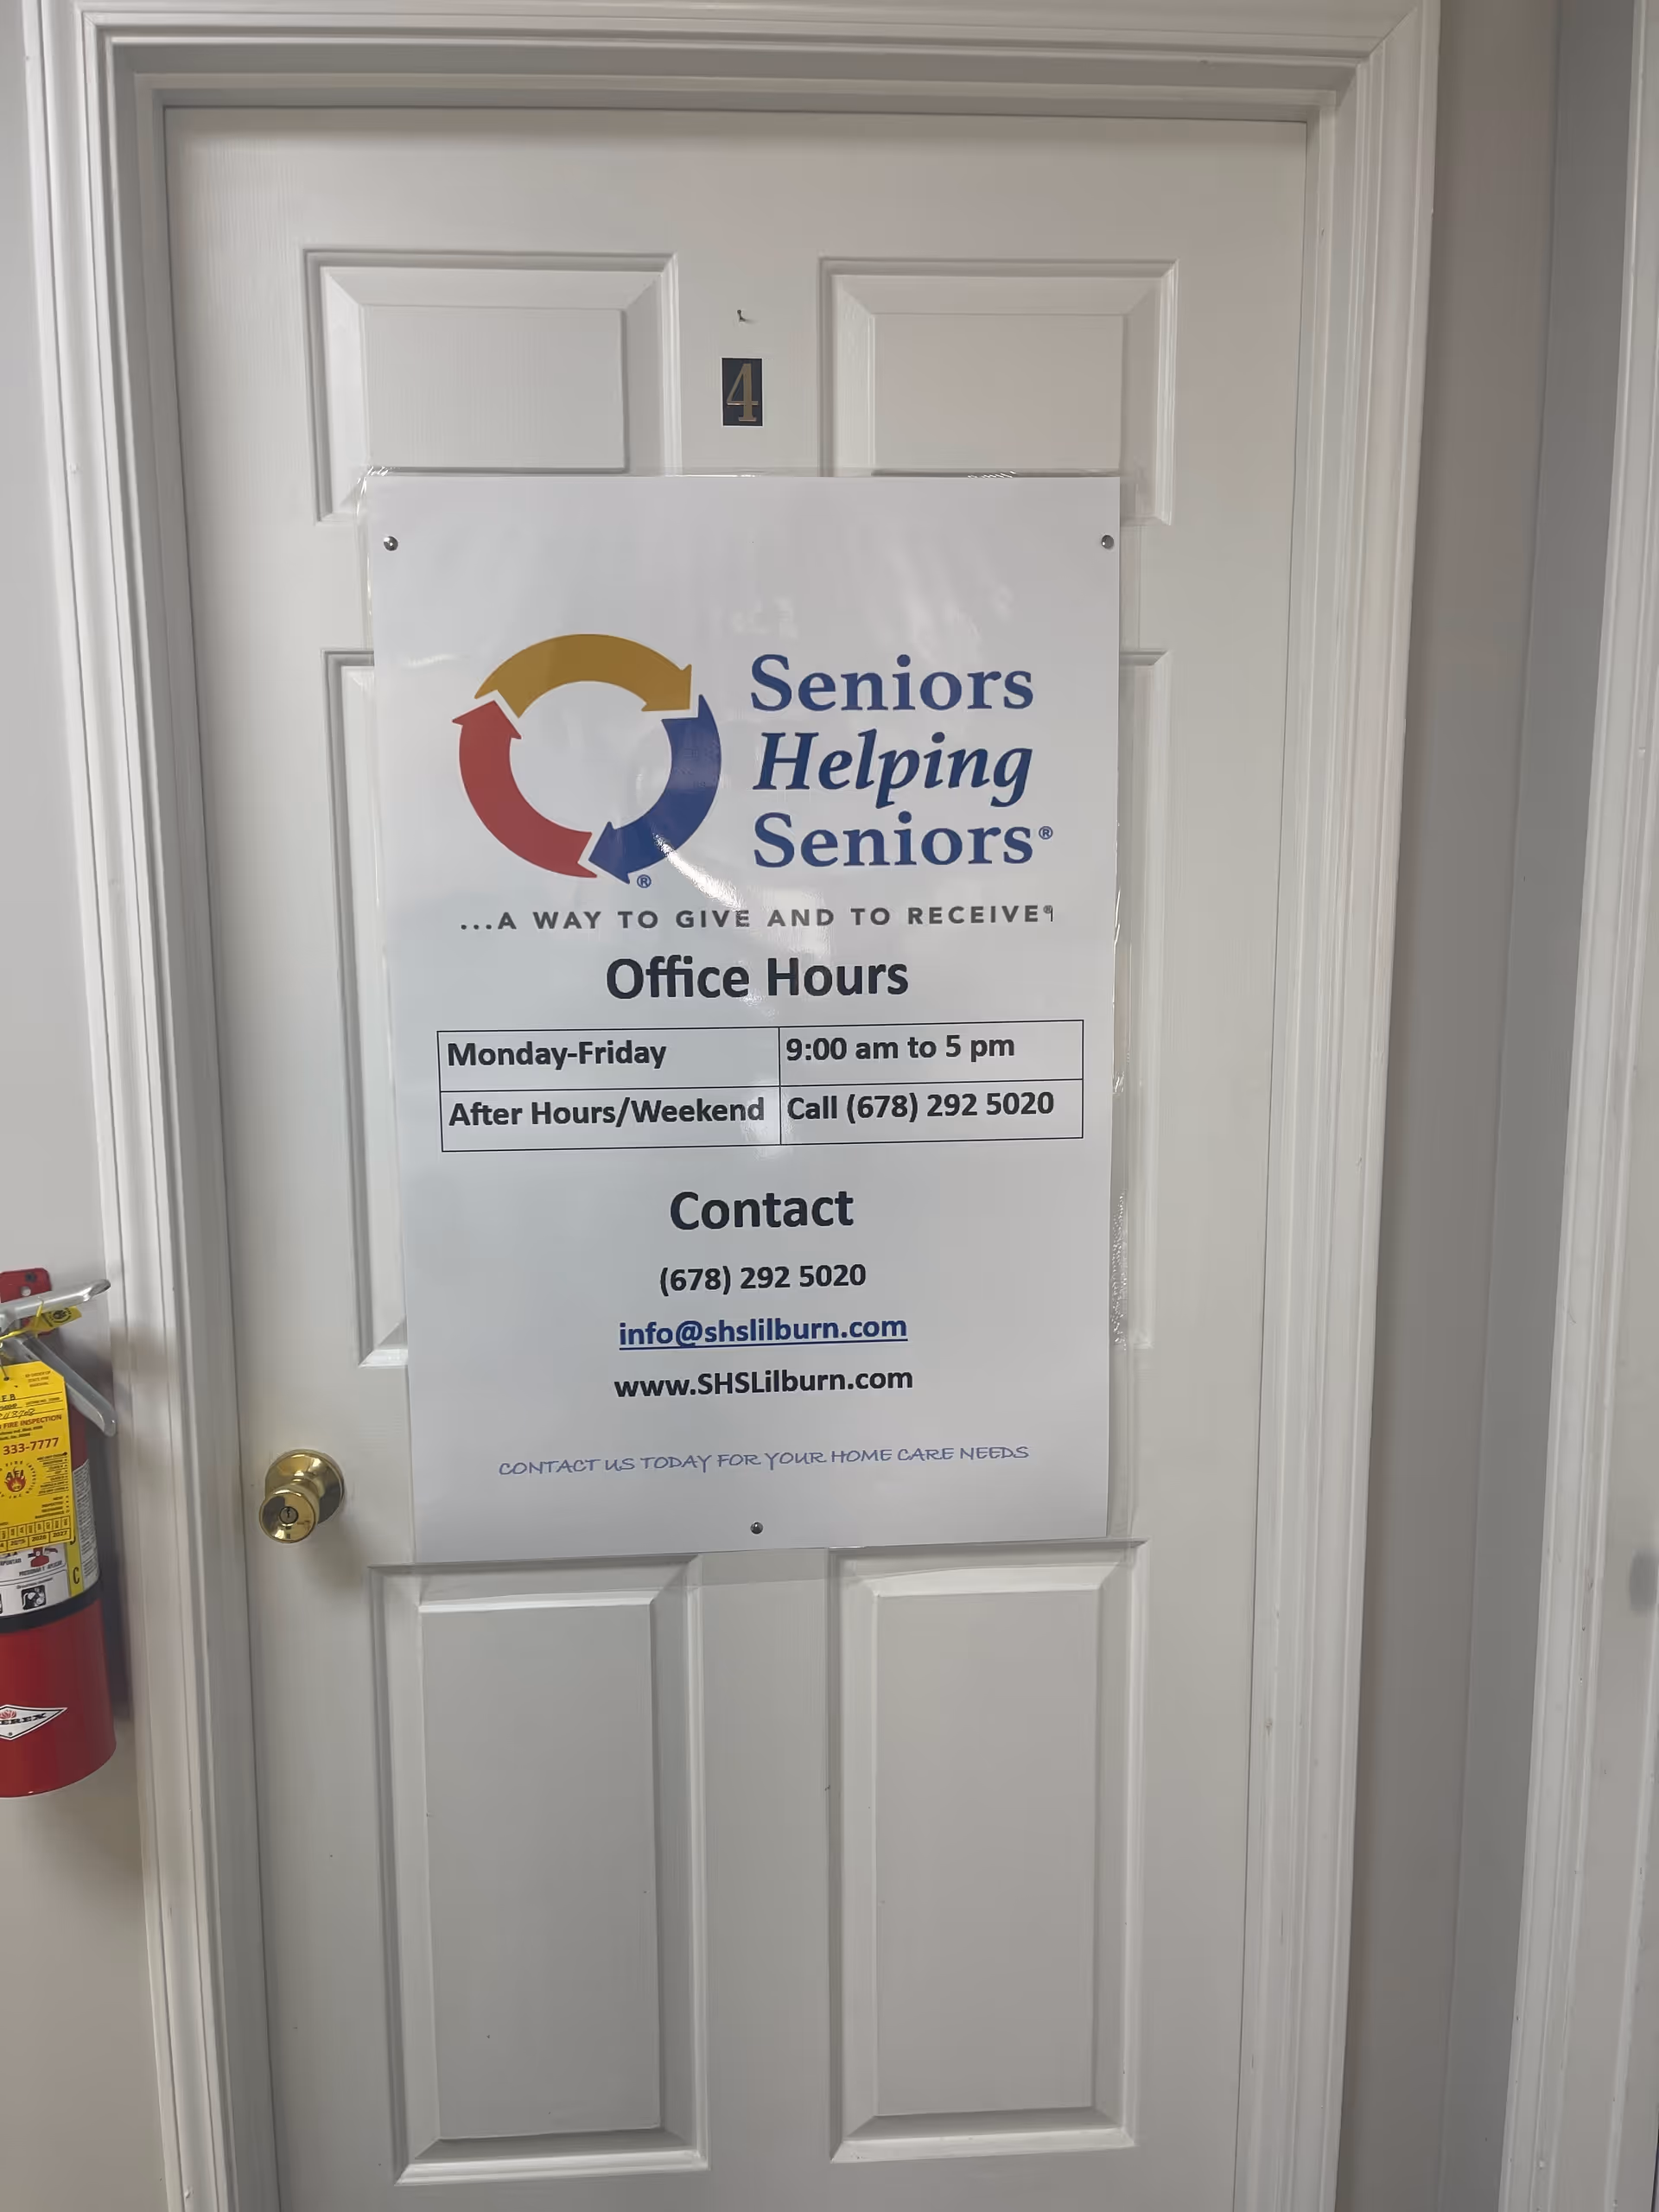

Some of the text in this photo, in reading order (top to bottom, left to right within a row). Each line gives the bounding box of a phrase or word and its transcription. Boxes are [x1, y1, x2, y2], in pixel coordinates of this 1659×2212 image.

[726, 363, 760, 423] 4
[750, 654, 1034, 712] Seniors
[752, 729, 1033, 809] Helping
[532, 911, 602, 930] WAY
[617, 910, 658, 929] TO
[675, 909, 751, 929] GIVE
[766, 908, 835, 927] AND
[849, 907, 891, 926] TO
[606, 954, 909, 1001] Office Hours
[447, 1039, 668, 1071] Monday-Friday
[785, 1034, 1015, 1064] 9:00 am to 5 pm
[448, 1096, 765, 1129] After Hours/Weekend
[786, 1090, 1055, 1125] Call (678) 292 5020
[670, 1189, 855, 1231] Contact
[659, 1263, 867, 1298] (678) 292 5020
[619, 1316, 909, 1350] info@shslilburn.com
[613, 1369, 913, 1399] www.SHSLilburn.com
[3, 1414, 62, 1429] FIRE INSPECTION
[3, 1437, 60, 1456] 333-7777
[499, 1446, 1030, 1475] CONTACT US TODAY FOR YOUR HOME CARE NEEDS
[73, 1567, 80, 1585] C
